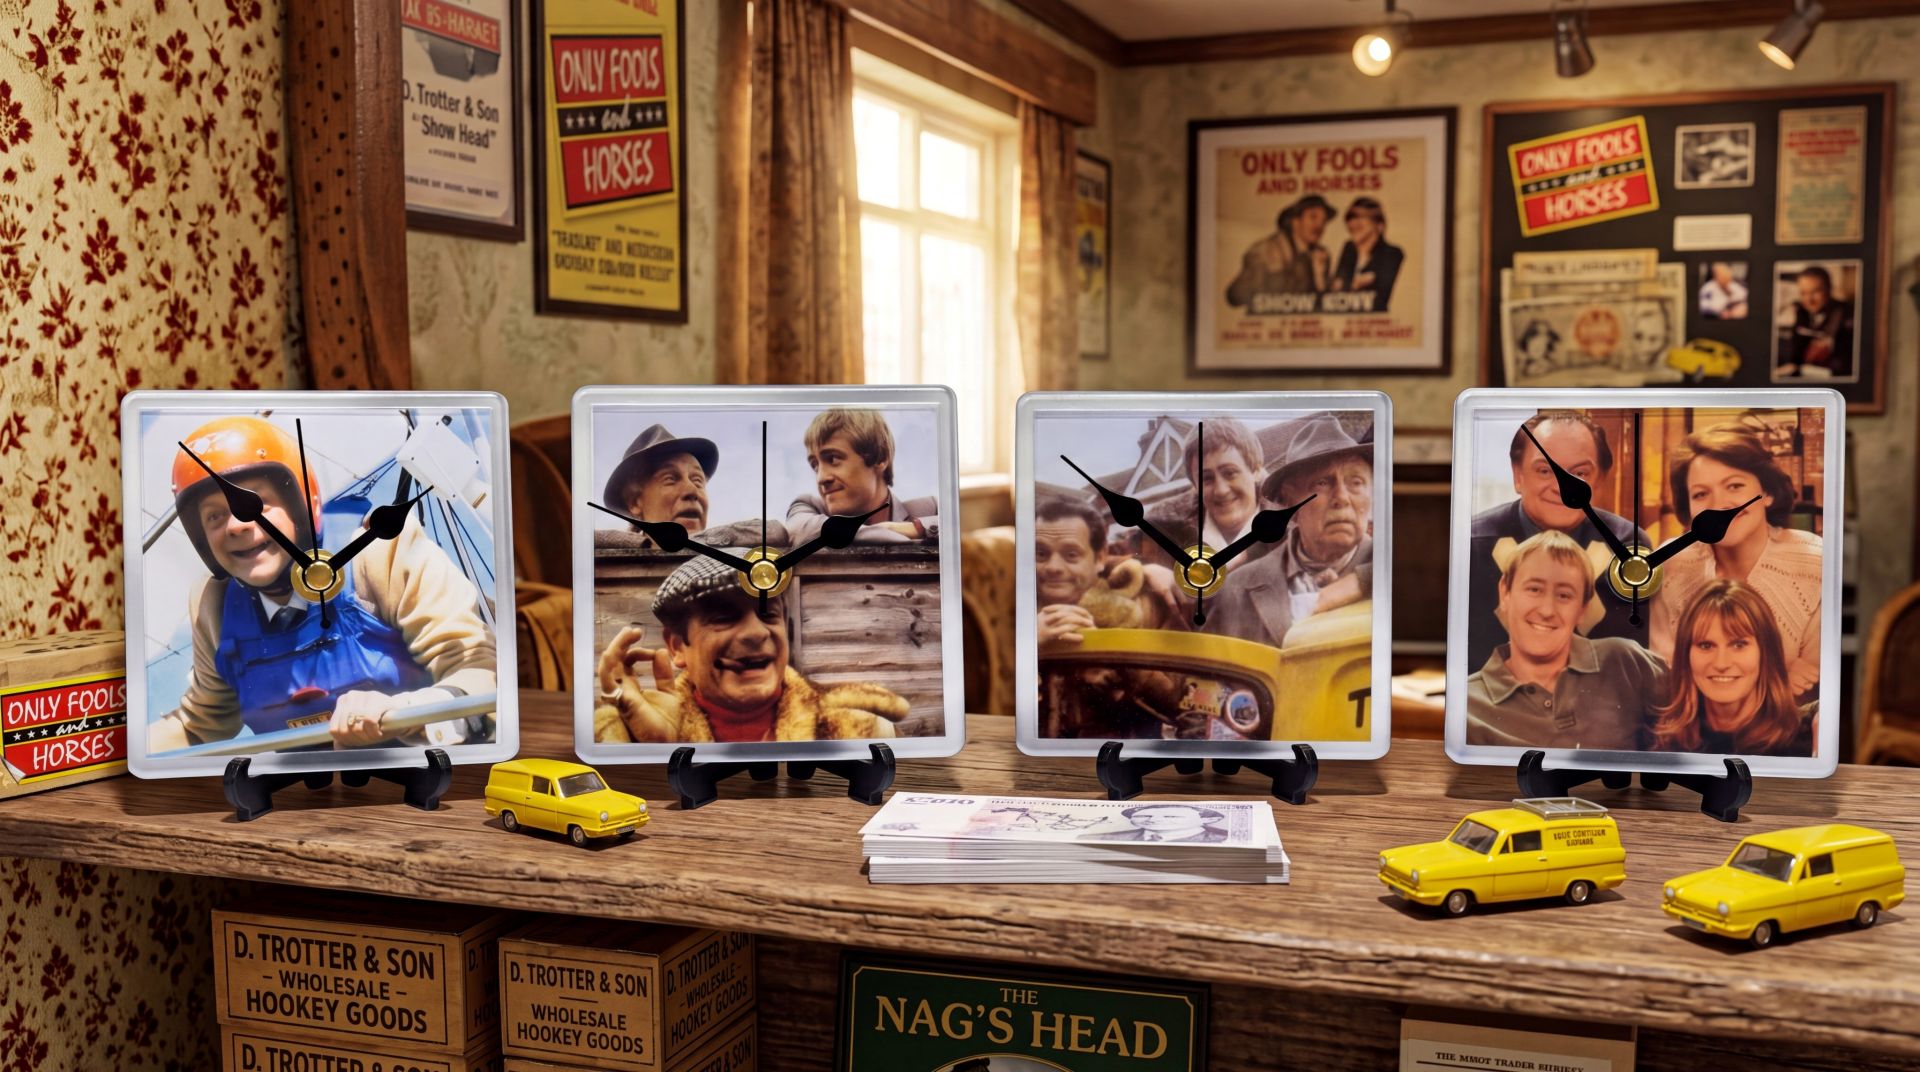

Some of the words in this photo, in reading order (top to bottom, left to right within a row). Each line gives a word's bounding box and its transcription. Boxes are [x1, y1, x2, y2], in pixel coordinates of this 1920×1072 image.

[560, 48, 603, 94] ONLY
[610, 46, 660, 92] FOOLS
[416, 83, 460, 113] Trotter
[464, 97, 474, 117] &
[476, 100, 499, 123] Son
[601, 95, 631, 130] and
[583, 139, 654, 194] HORSES
[1242, 150, 1308, 176] ONLY
[1317, 146, 1399, 172] FOOLS
[1521, 142, 1573, 177] ONLY
[1575, 127, 1638, 164] FOOLS
[1257, 176, 1297, 195] AND
[1304, 173, 1382, 194] HORSES
[1544, 178, 1629, 223] HORSES
[7, 693, 62, 725] ONLY
[68, 683, 126, 715] FOOLS
[55, 712, 89, 736] and
[33, 731, 115, 771] HORSES
[234, 930, 255, 961] D.
[258, 932, 356, 972] TROTTER
[363, 945, 380, 974] &
[386, 948, 435, 981] SON
[667, 970, 676, 996] D.
[678, 941, 719, 987] TROTTER
[722, 936, 729, 960] &
[278, 969, 390, 999] WHOLESALE
[509, 961, 525, 983] D.
[527, 963, 596, 992] TROTTER
[599, 973, 612, 994] &
[614, 974, 648, 998] SON
[686, 963, 735, 1008] WHOLESALE
[1000, 988, 1039, 1005] THE
[246, 988, 339, 1023] HOOKEY
[346, 1000, 428, 1035] GOODS
[532, 1004, 627, 1031] WHOLESALE
[671, 998, 713, 1046] HOOKEY
[716, 976, 748, 1013] GOODS
[875, 995, 1015, 1045] NAG'S
[1030, 1010, 1168, 1060] HEAD
[242, 1044, 262, 1072] D.
[517, 1021, 582, 1048] HOOKEY
[586, 1031, 644, 1057] GOODS
[733, 1036, 752, 1068] SON
[1435, 1052, 1456, 1061] THE
[1494, 1058, 1535, 1070] TRADER
